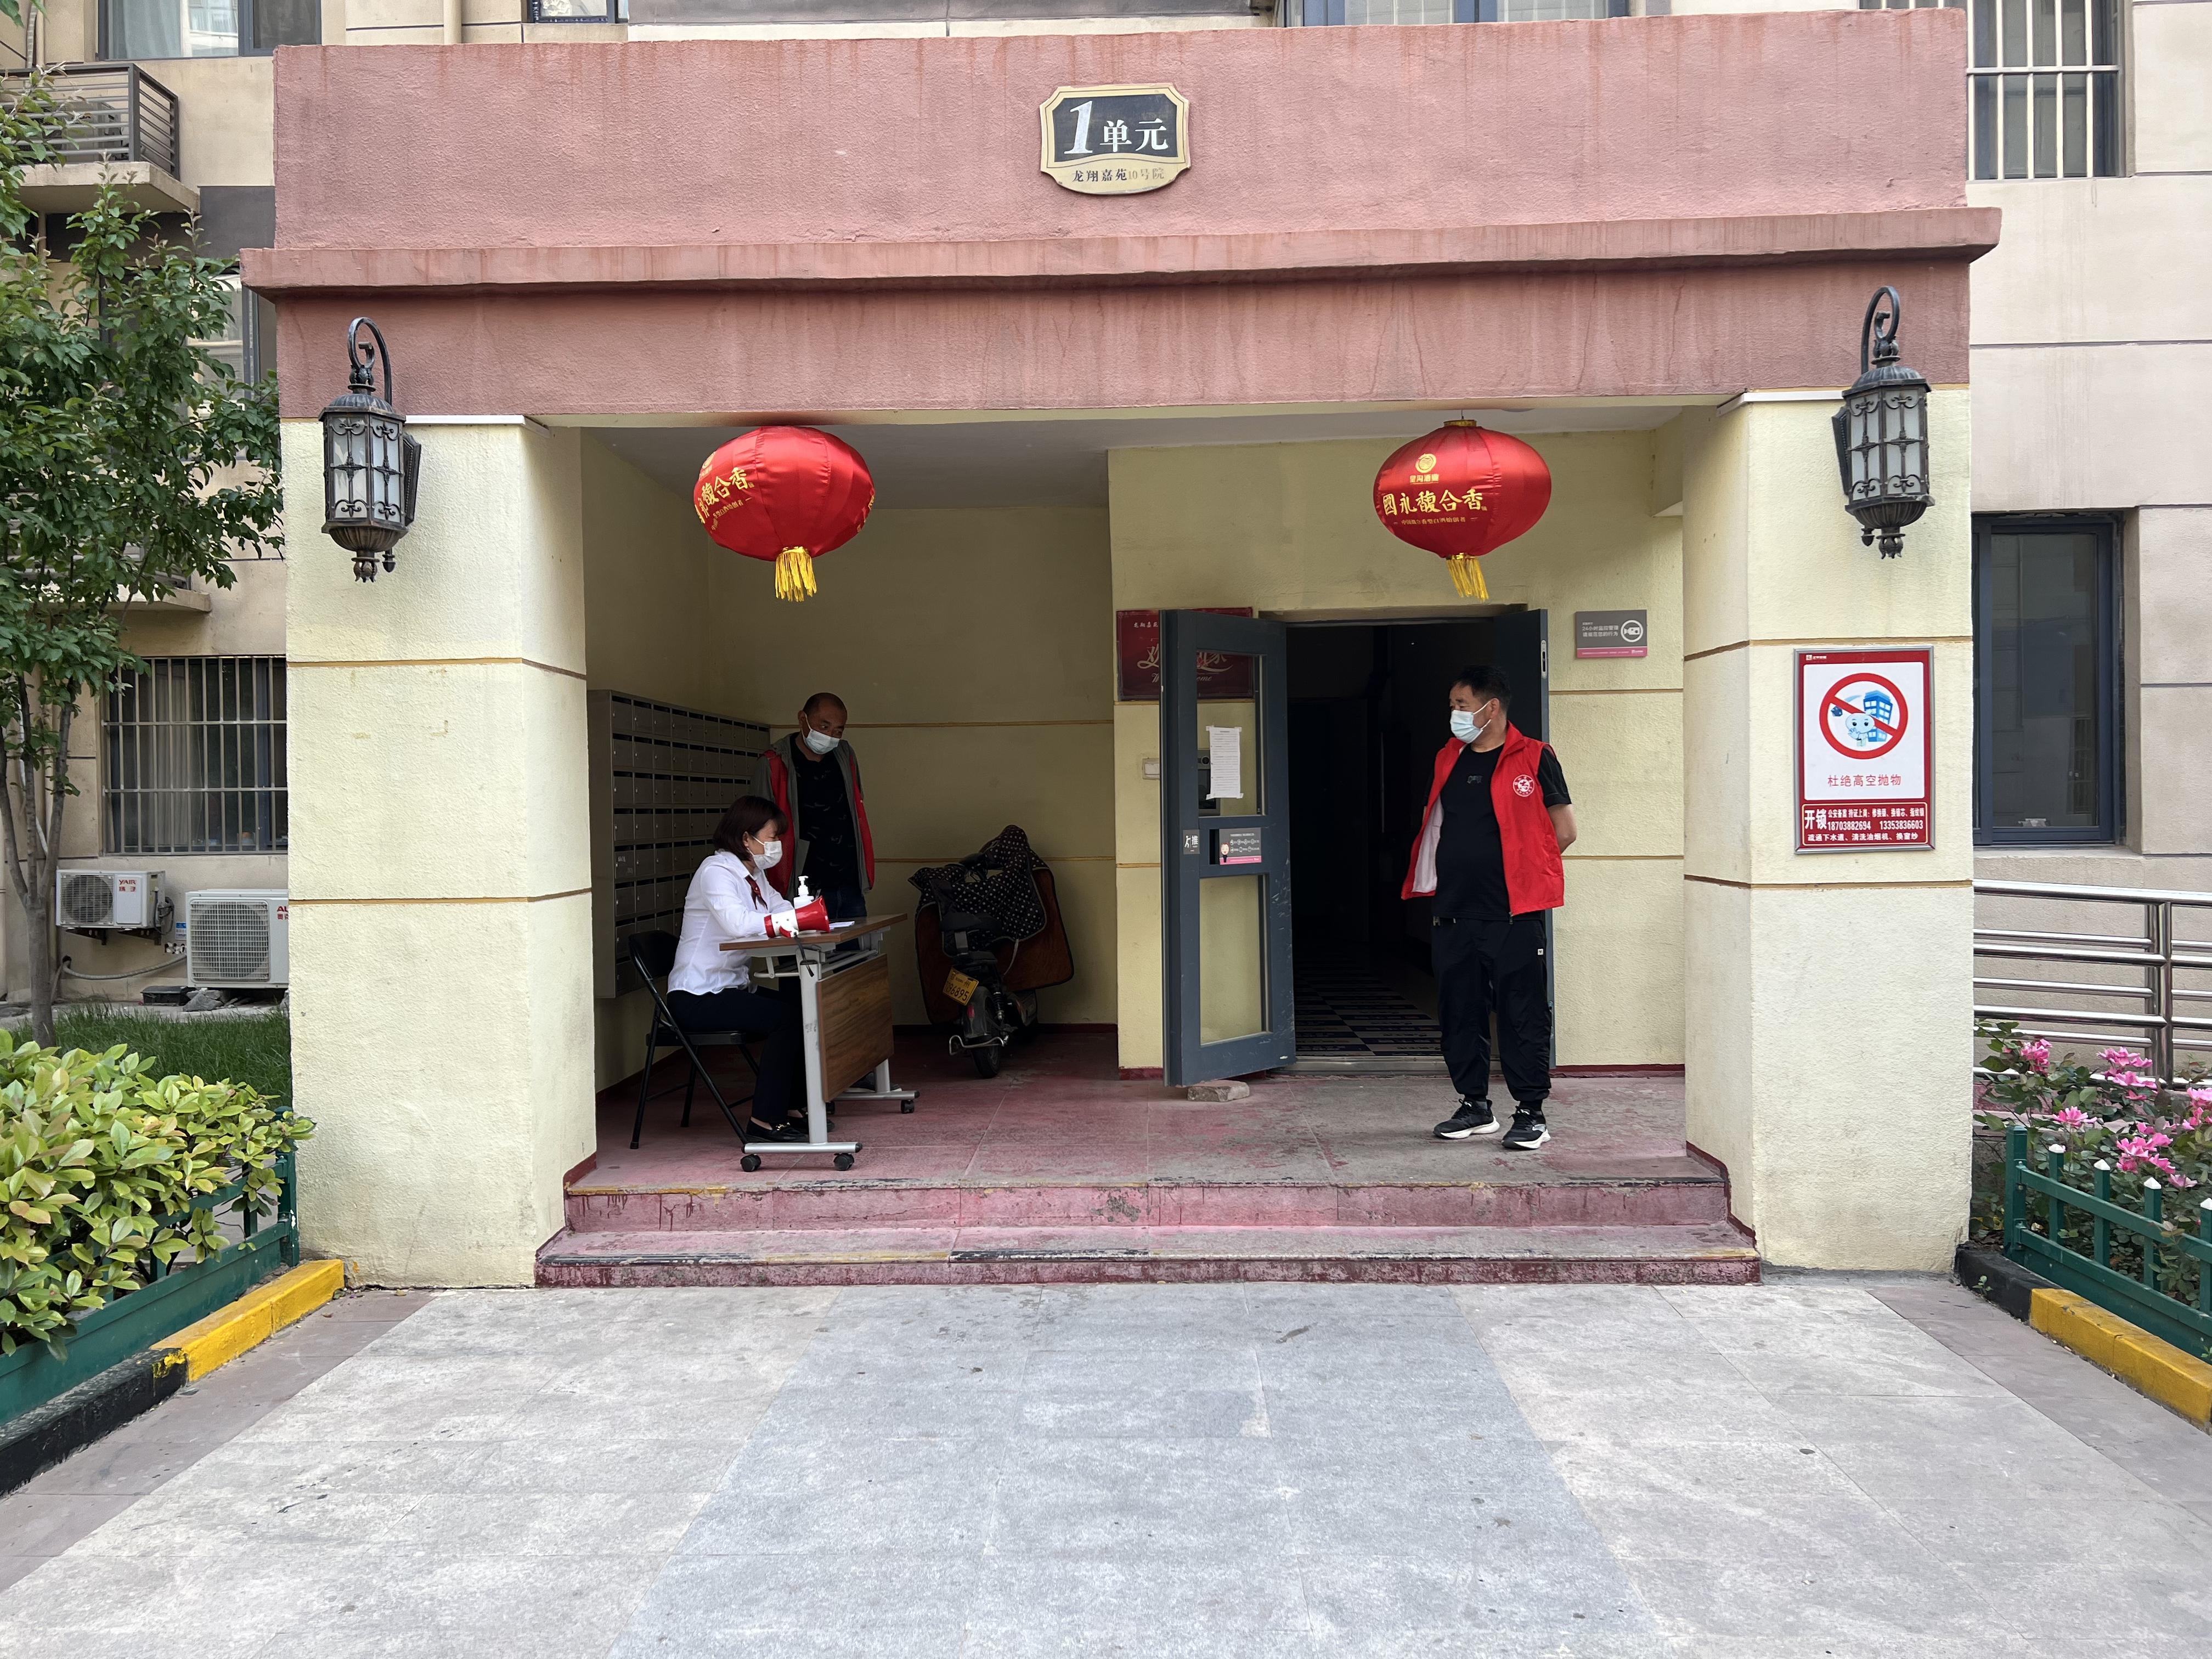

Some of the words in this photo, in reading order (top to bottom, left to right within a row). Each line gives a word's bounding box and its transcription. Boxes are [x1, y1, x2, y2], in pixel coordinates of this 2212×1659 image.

[1064, 100, 1169, 154] 1单元
[1072, 168, 1165, 183] 龙翔嘉苑10号院
[1827, 774, 1901, 787] 杜绝高空抛物
[1804, 809, 1827, 830] 开锁
[1827, 821, 1871, 831] 18703882694
[1880, 820, 1923, 830] 13353836603
